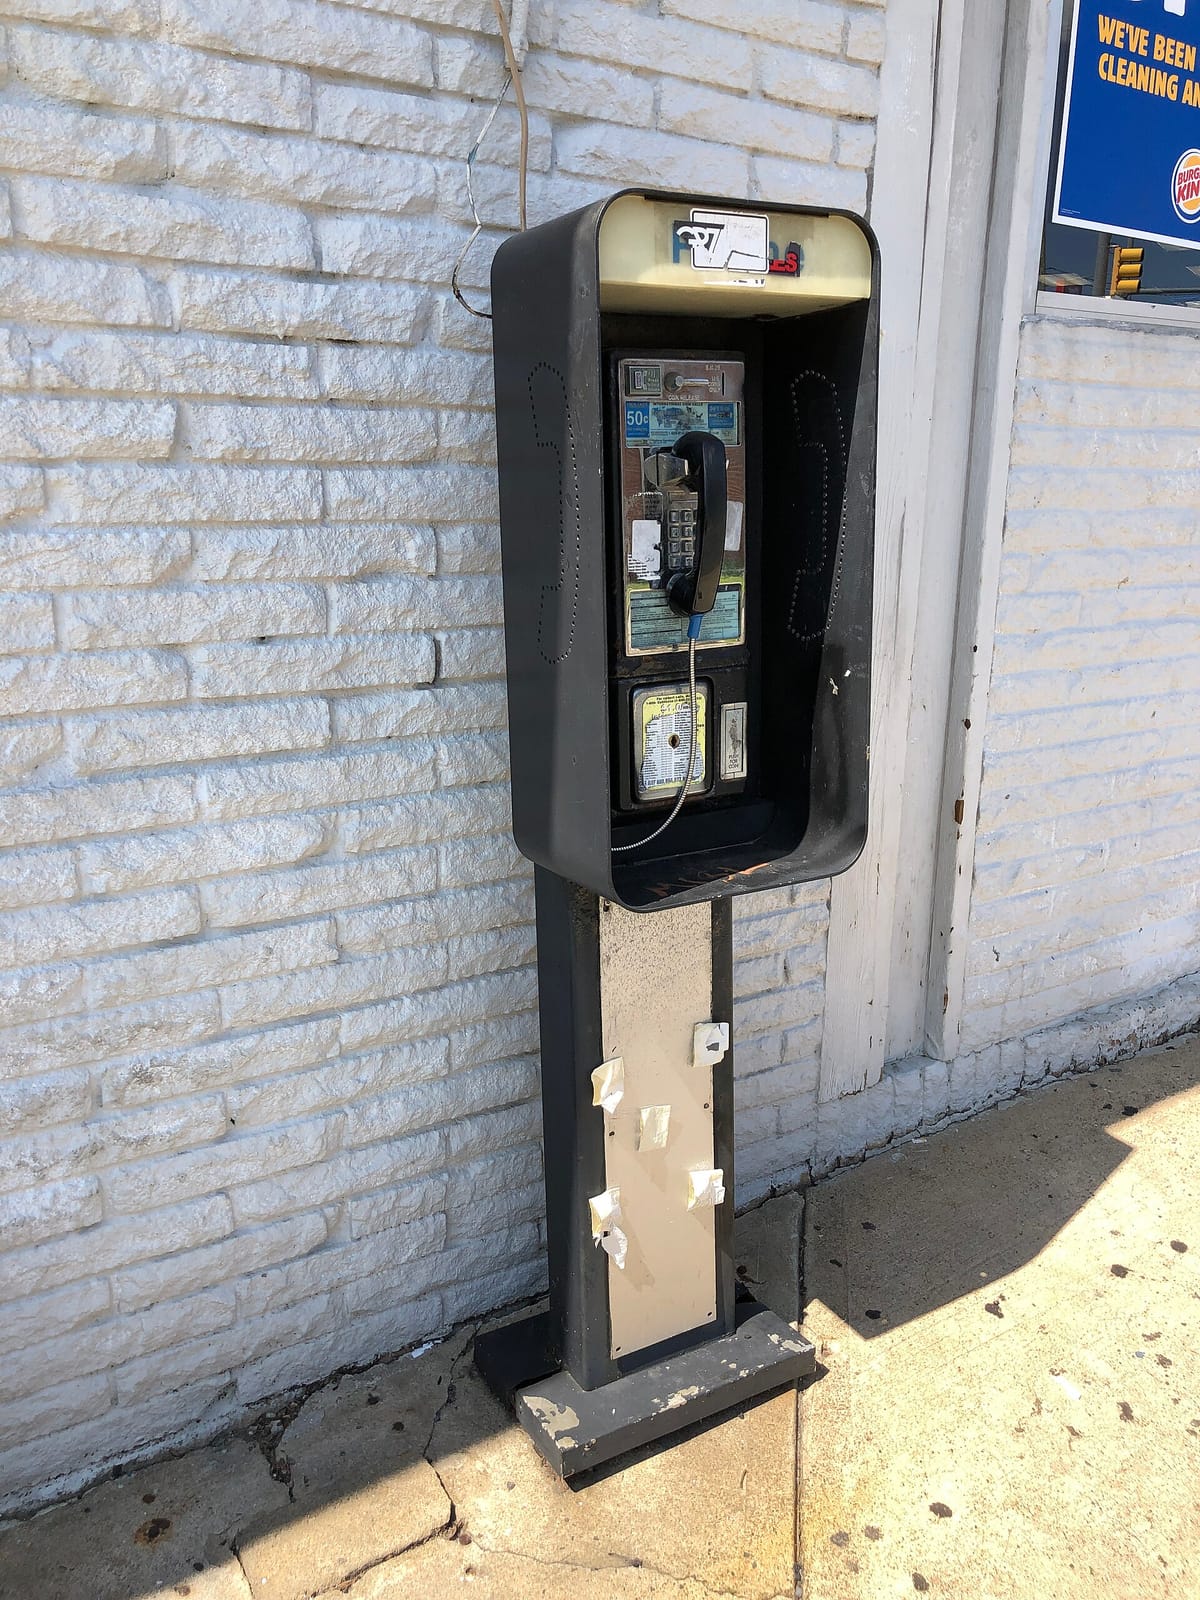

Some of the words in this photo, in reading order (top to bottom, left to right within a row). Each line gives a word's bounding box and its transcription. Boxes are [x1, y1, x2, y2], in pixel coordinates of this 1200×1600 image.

[1098, 14, 1150, 57] WE'VE
[1153, 33, 1197, 72] BEEN
[1098, 53, 1179, 101] CLEANING
